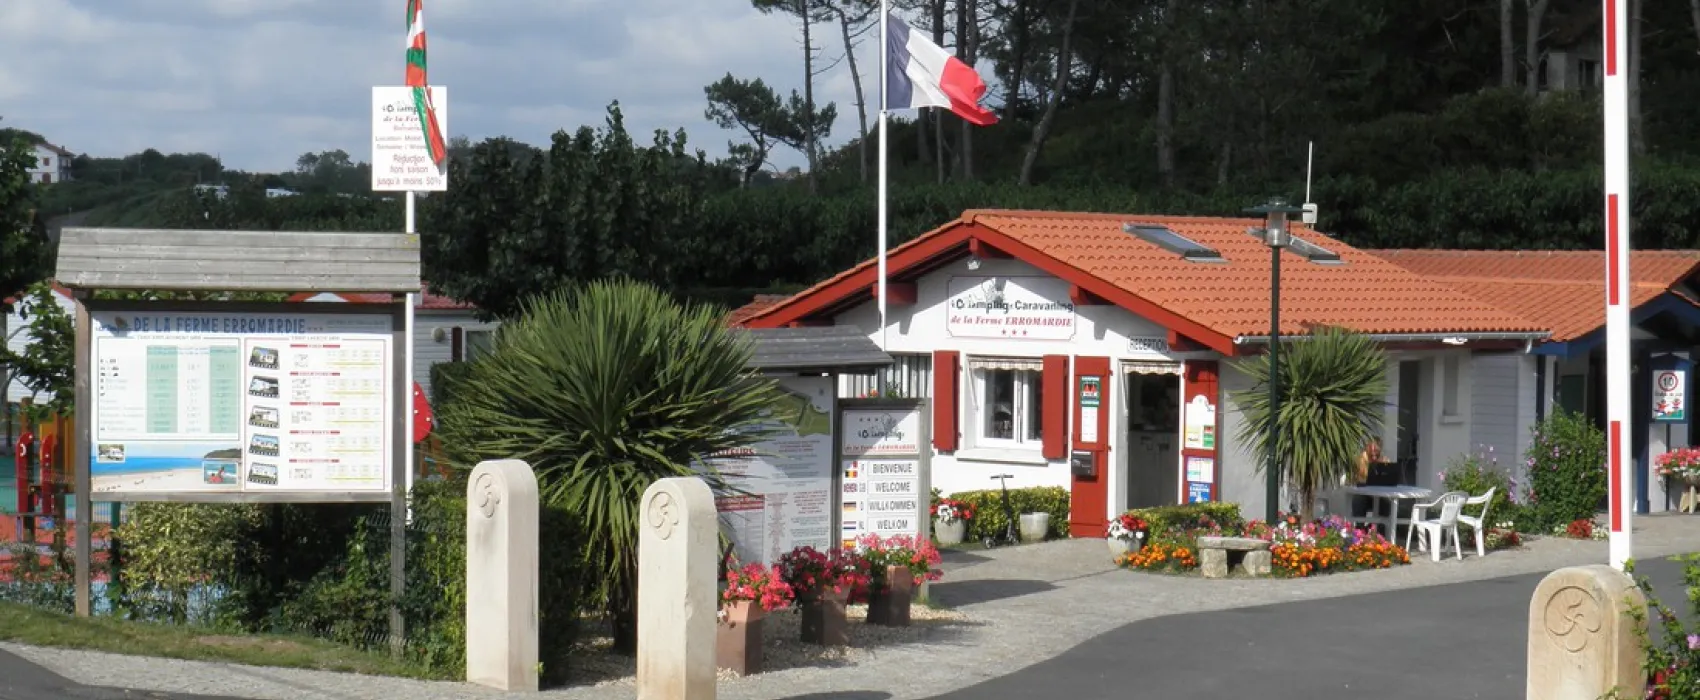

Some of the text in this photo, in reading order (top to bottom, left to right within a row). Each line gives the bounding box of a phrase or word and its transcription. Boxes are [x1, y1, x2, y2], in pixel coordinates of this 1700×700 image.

[133, 316, 150, 332] DE
[155, 316, 171, 332] LA
[176, 316, 219, 333] FERME
[223, 317, 306, 333] ERROMARDIE
[950, 316, 1073, 326] de la Ferme ERROMARDIE
[1663, 376, 1674, 387] 10
[872, 463, 913, 474] BIENVENUE
[875, 481, 911, 492] WELCOME
[869, 501, 916, 512] WILLKOMMEN
[876, 519, 908, 530] WELKOM
